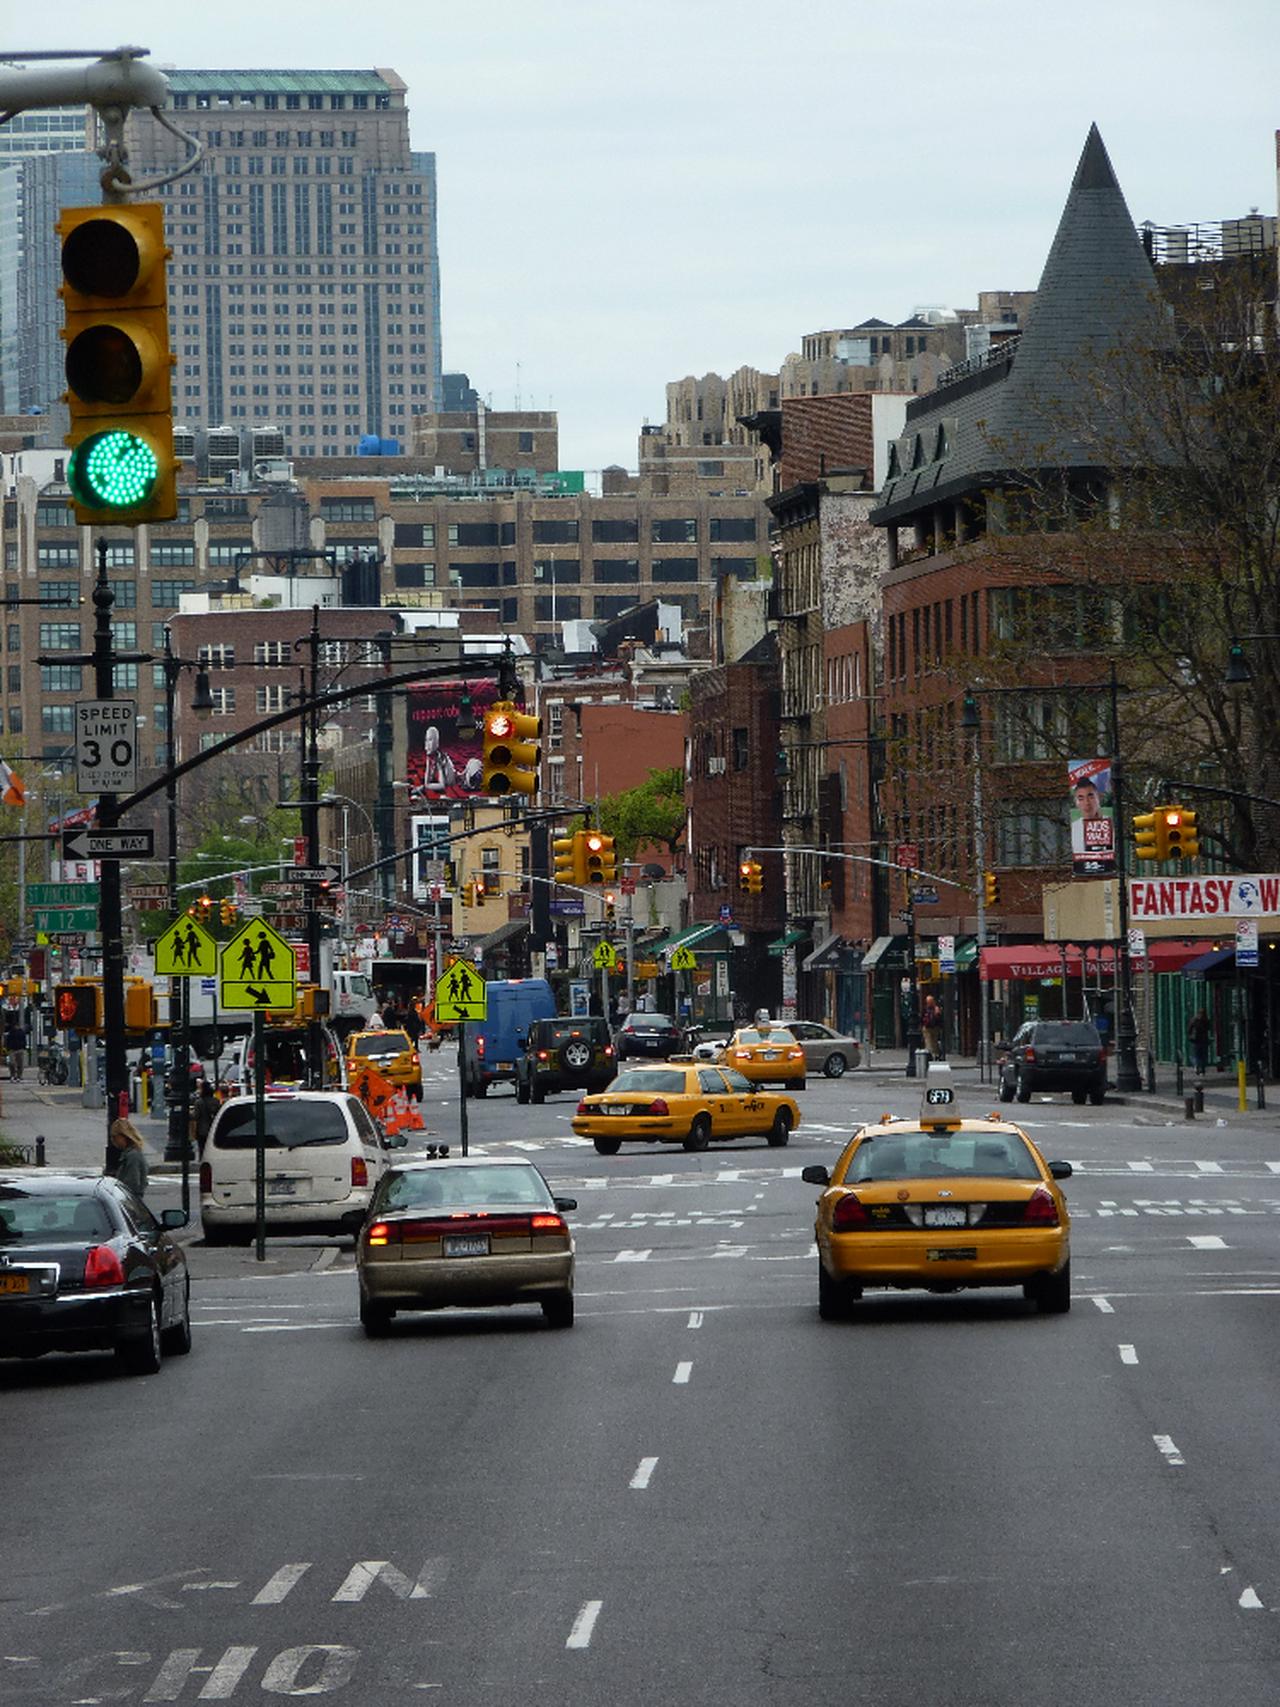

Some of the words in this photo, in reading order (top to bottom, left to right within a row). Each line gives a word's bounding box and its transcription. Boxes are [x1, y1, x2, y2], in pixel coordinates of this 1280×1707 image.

[80, 707, 132, 720] SPEED
[84, 723, 127, 736] LIMIT
[81, 740, 132, 768] 30
[1086, 822, 1110, 833] AIDS
[1086, 833, 1111, 841] WALK
[90, 840, 113, 850] ONE
[121, 838, 144, 849] WAY
[1131, 880, 1233, 915] FANTASY
[38, 913, 49, 930] W
[60, 912, 75, 929] 12
[1010, 963, 1071, 976] VILLAGE
